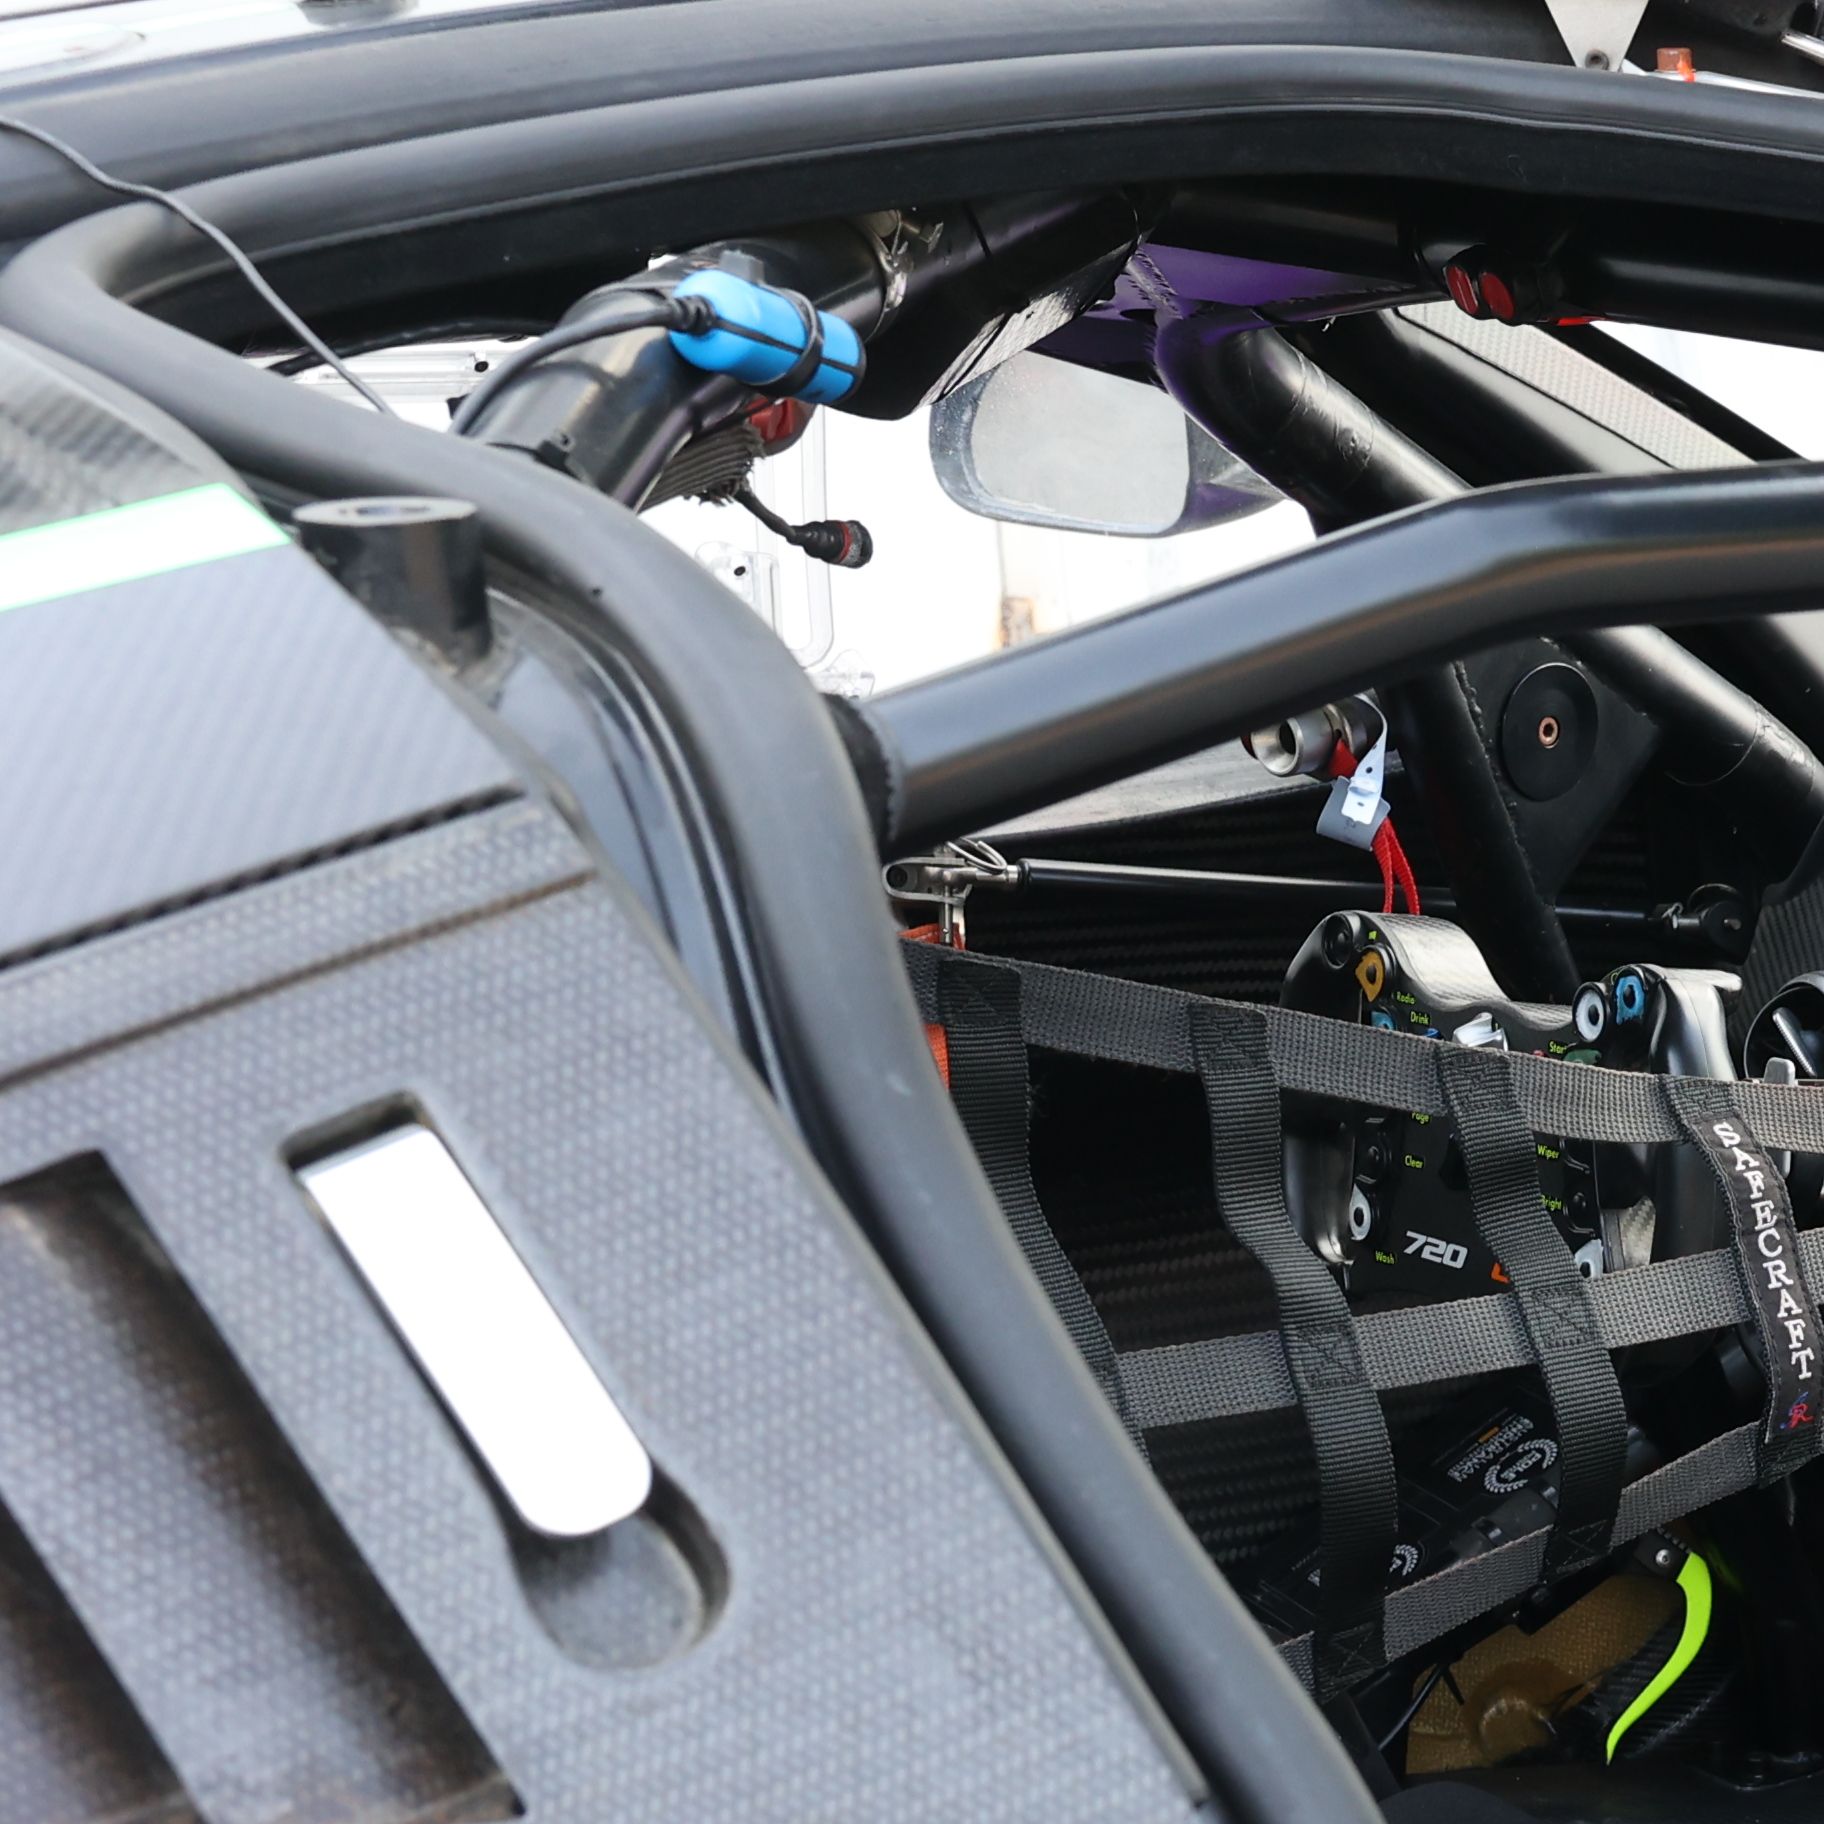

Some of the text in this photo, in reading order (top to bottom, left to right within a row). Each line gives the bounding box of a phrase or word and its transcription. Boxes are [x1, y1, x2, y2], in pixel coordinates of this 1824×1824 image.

[1410, 1011, 1429, 1025] Drink
[1537, 1145, 1560, 1160] Wiper
[1404, 1155, 1424, 1169] Clear
[1403, 1230, 1468, 1270] 720
[1712, 1120, 1816, 1381] SAFECRAFT
[1375, 1251, 1396, 1265] Wash
